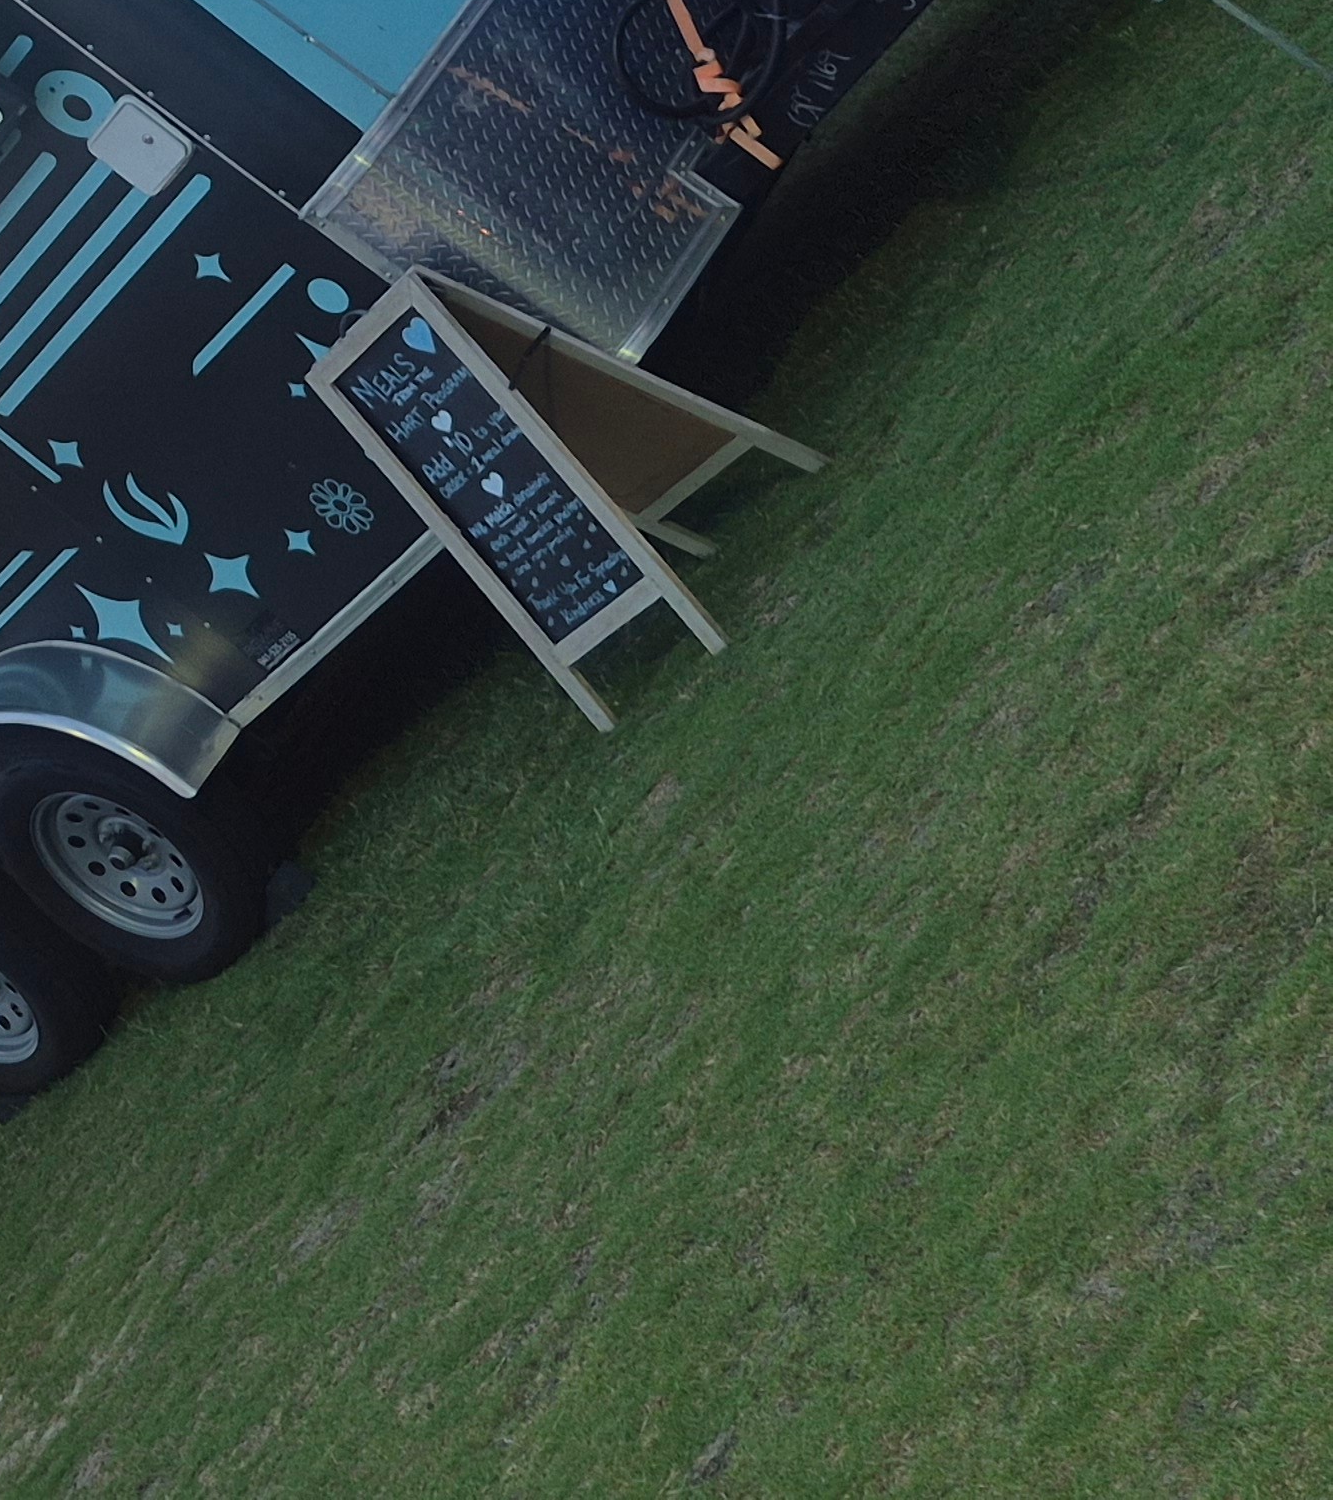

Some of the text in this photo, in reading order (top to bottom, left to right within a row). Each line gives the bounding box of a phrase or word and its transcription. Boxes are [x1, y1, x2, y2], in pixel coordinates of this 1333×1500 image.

[350, 352, 416, 410] MEALS
[385, 406, 425, 444] HART
[422, 450, 456, 485] Add
[471, 455, 486, 474] 1
